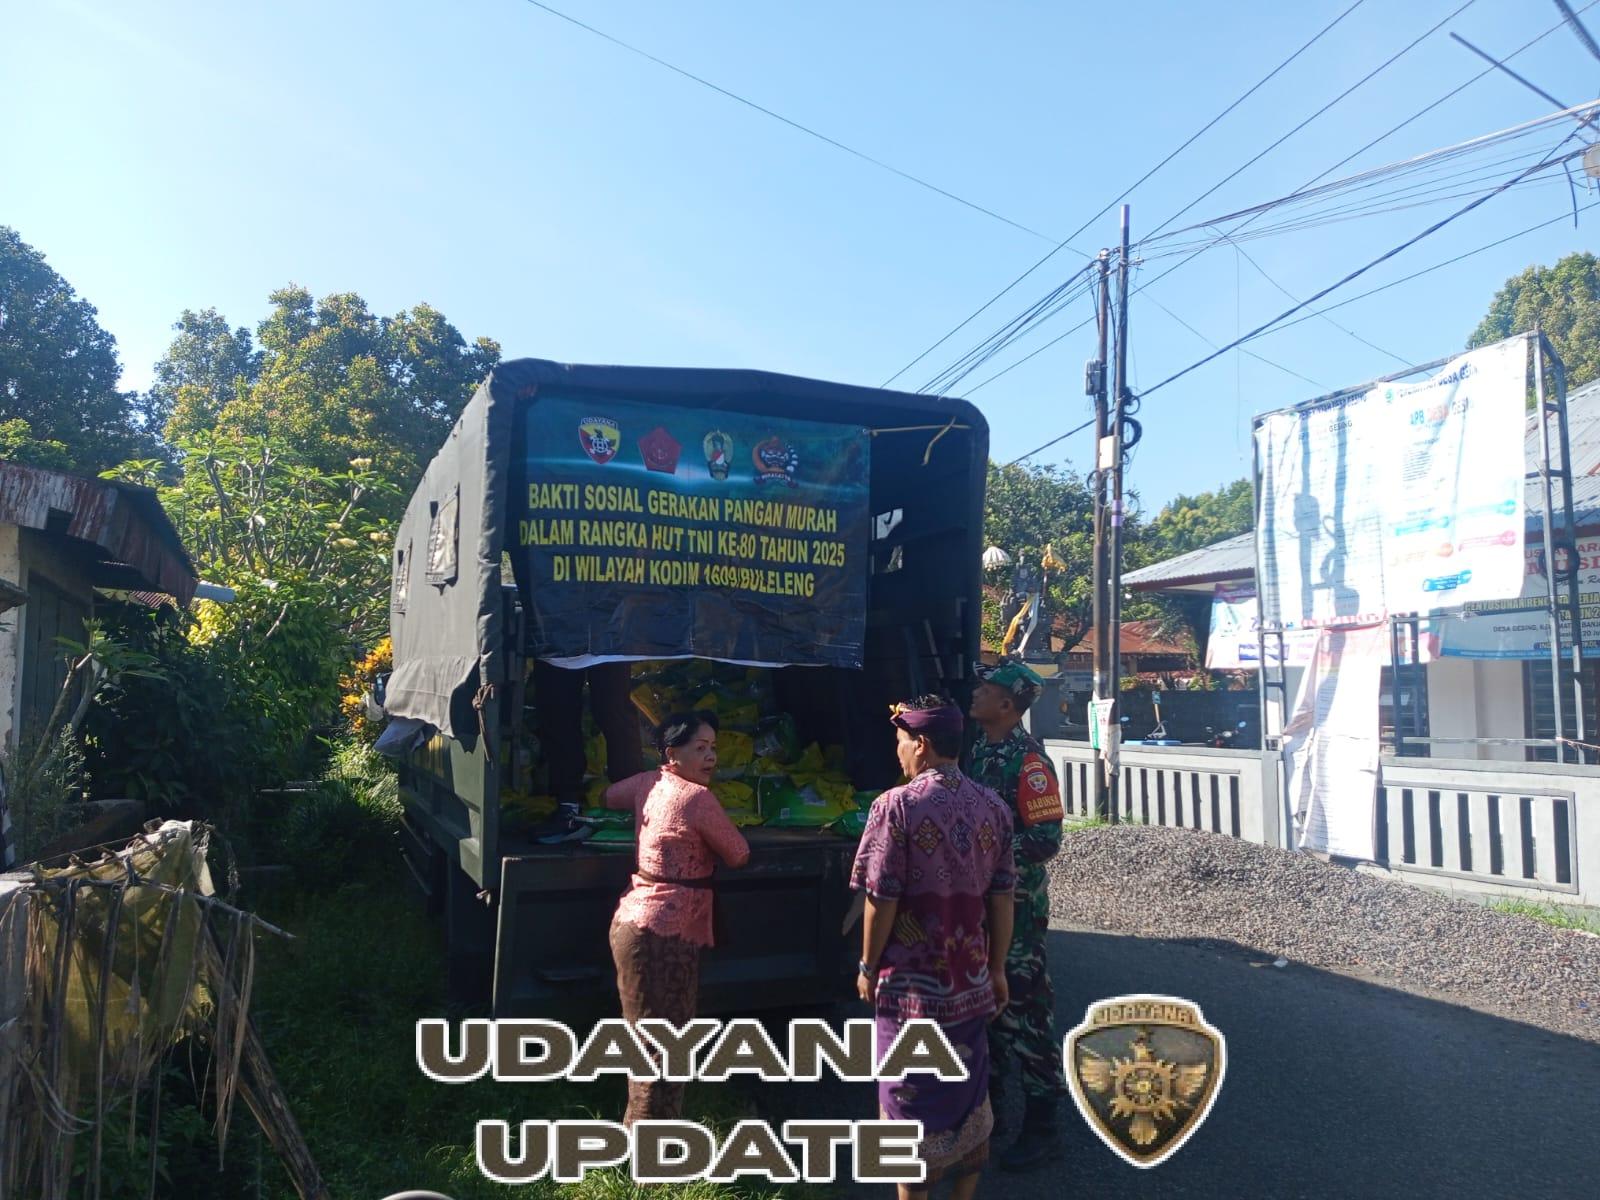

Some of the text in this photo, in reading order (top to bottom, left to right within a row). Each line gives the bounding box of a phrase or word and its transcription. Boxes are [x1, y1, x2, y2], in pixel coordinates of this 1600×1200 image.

[581, 416, 617, 428] UDAYANA
[528, 483, 837, 533] BAKTI SOSIAL GERAKAN PANGAN MURAH
[519, 519, 845, 567] DALAM RANGKA HUT TNI KE-80 TAHUN 2025
[553, 556, 815, 597] DI WILAYAH KODIM 1609/BULELENG
[1026, 794, 1060, 811] BABINSA
